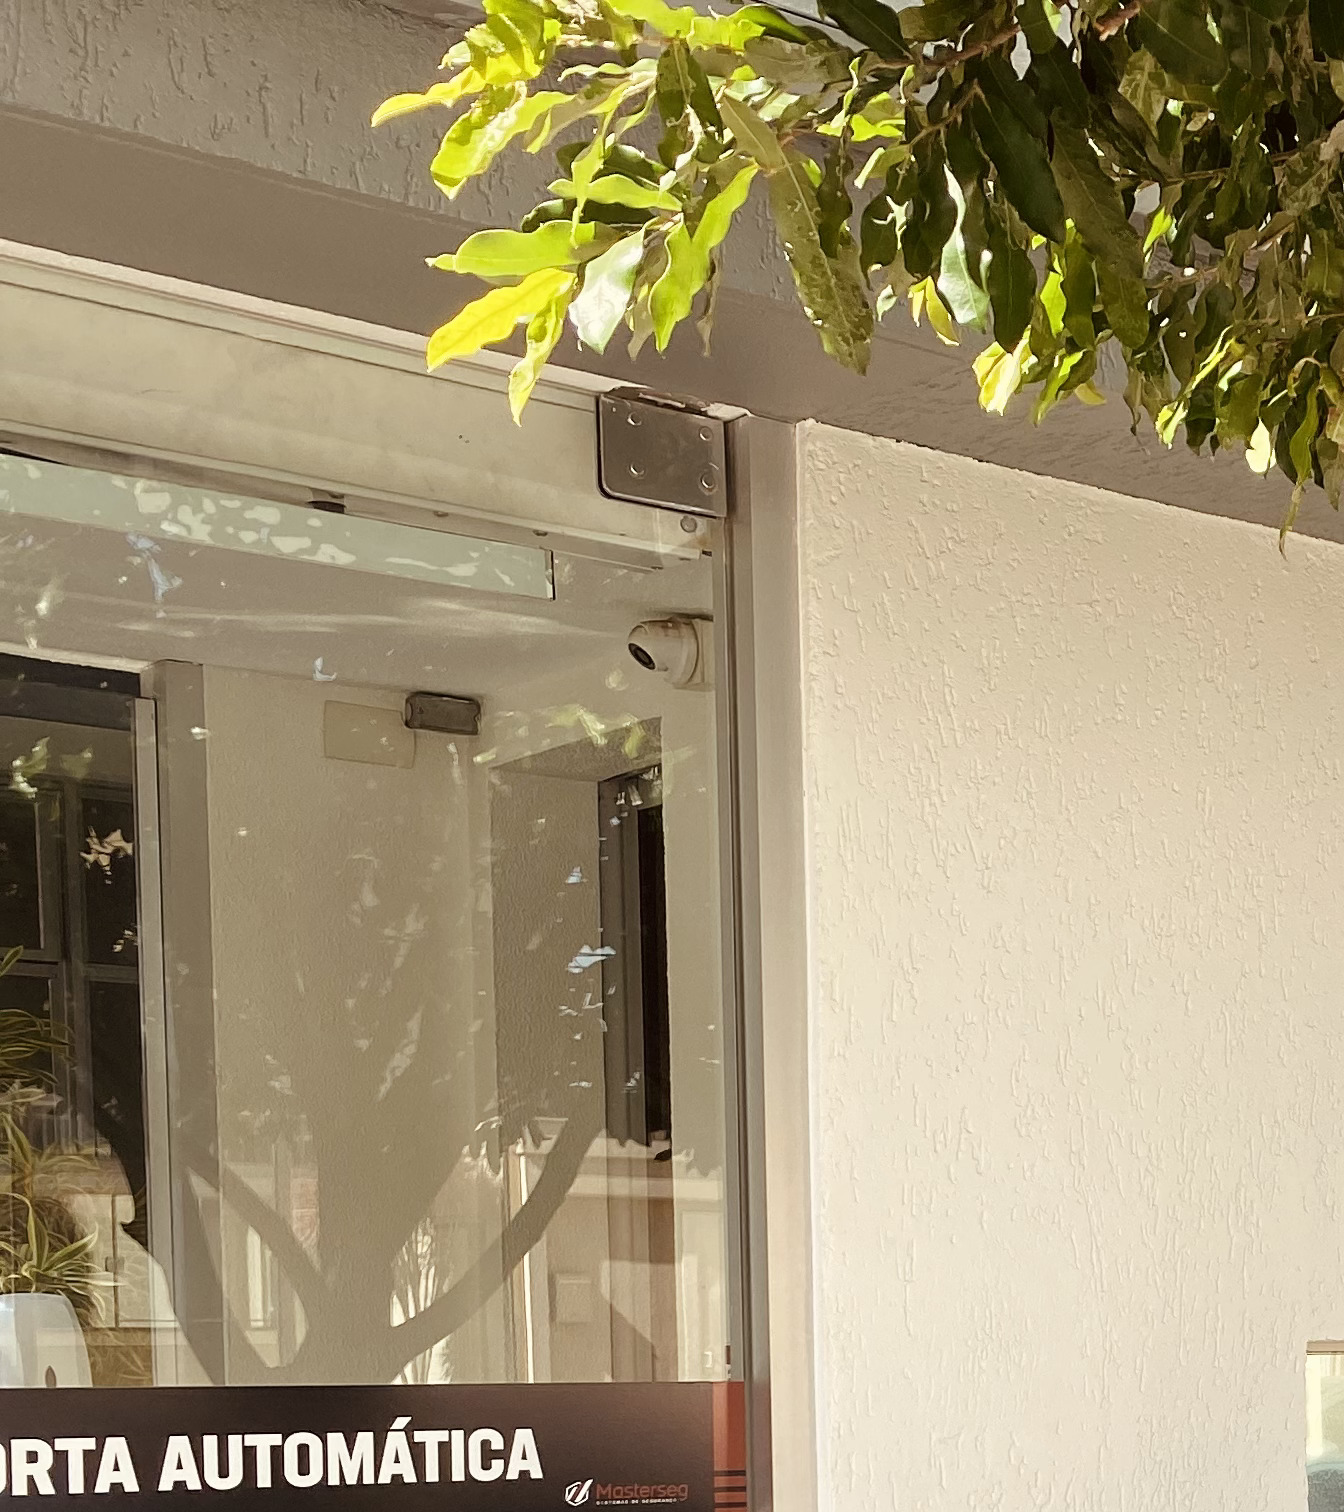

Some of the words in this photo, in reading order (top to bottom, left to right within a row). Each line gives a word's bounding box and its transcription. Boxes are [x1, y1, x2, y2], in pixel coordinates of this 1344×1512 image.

[0, 1436, 140, 1497] RTA
[157, 1417, 544, 1492] AUTOMÁTICA
[596, 1483, 689, 1501] Masterseg
